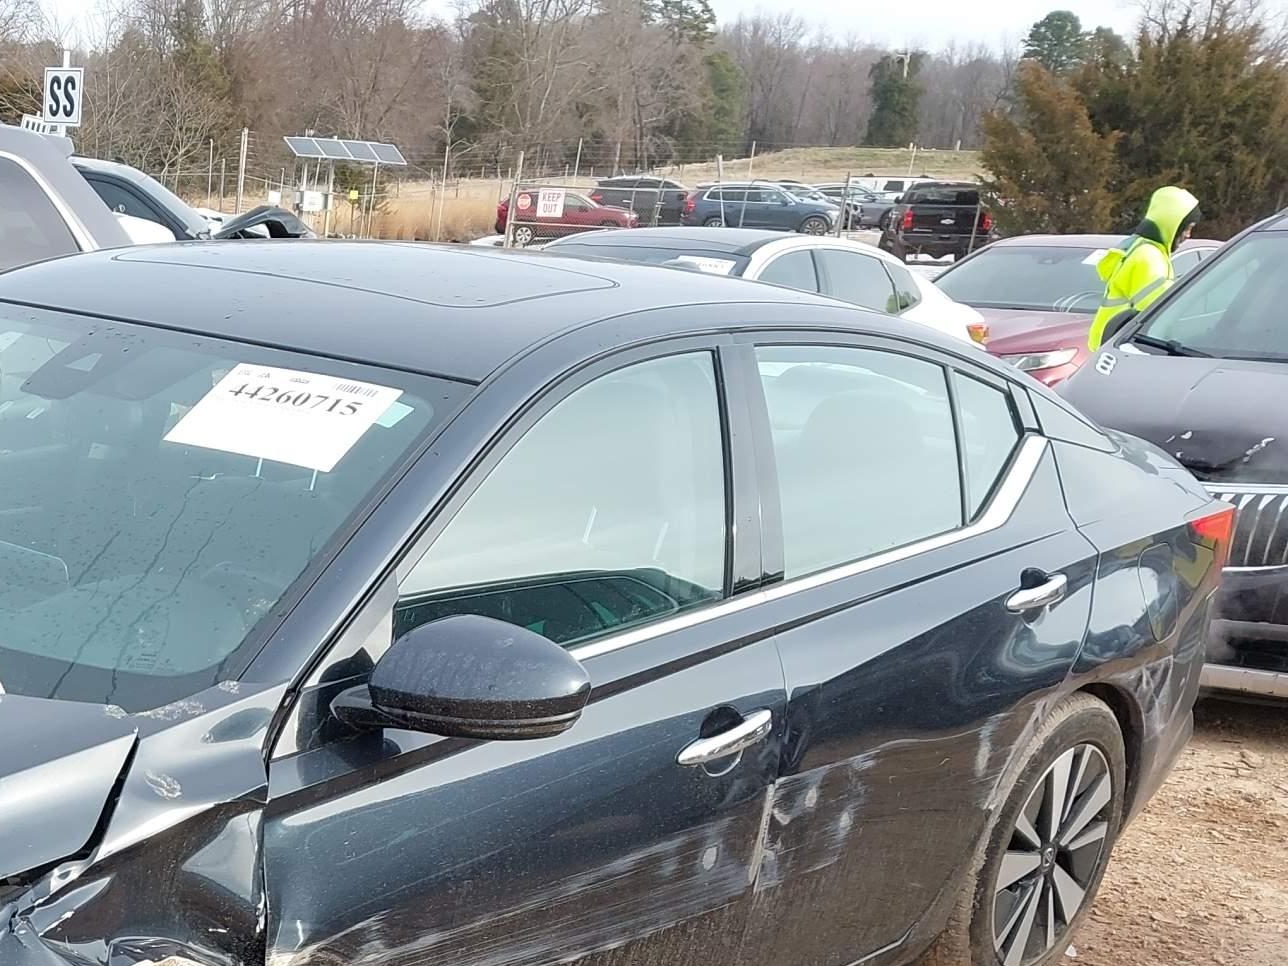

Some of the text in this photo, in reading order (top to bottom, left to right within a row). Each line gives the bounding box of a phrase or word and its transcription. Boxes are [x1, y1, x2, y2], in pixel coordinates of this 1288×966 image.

[48, 75, 76, 117] SS
[542, 192, 561, 202] KEEP
[543, 203, 558, 213] OUT
[228, 383, 364, 416] 44260715
